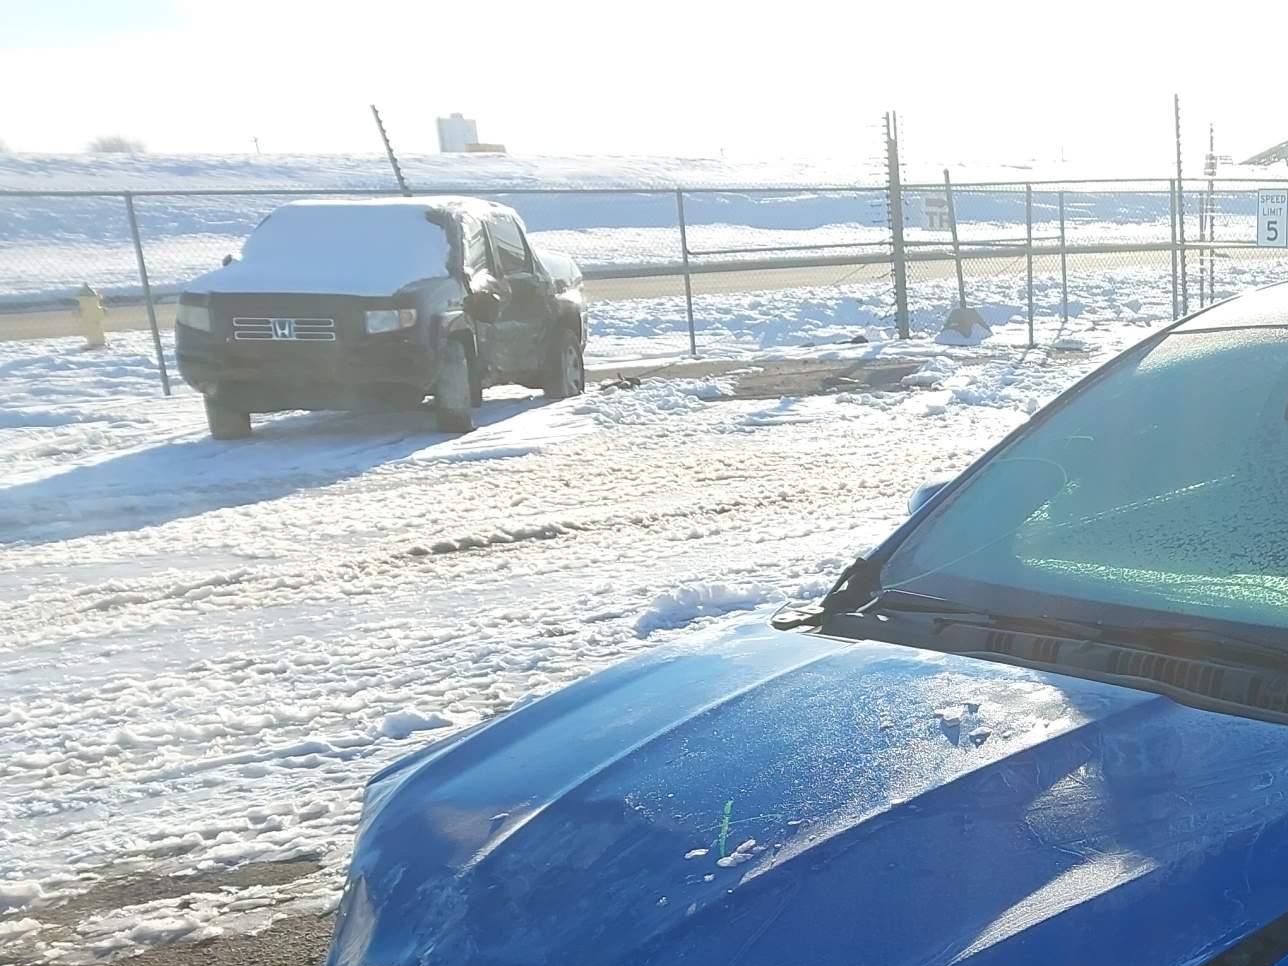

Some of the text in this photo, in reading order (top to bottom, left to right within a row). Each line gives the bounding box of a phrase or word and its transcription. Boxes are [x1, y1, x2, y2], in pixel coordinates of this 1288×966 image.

[1260, 194, 1286, 203] SPEED
[1262, 207, 1283, 216] LIMIT
[1266, 220, 1279, 241] 5
